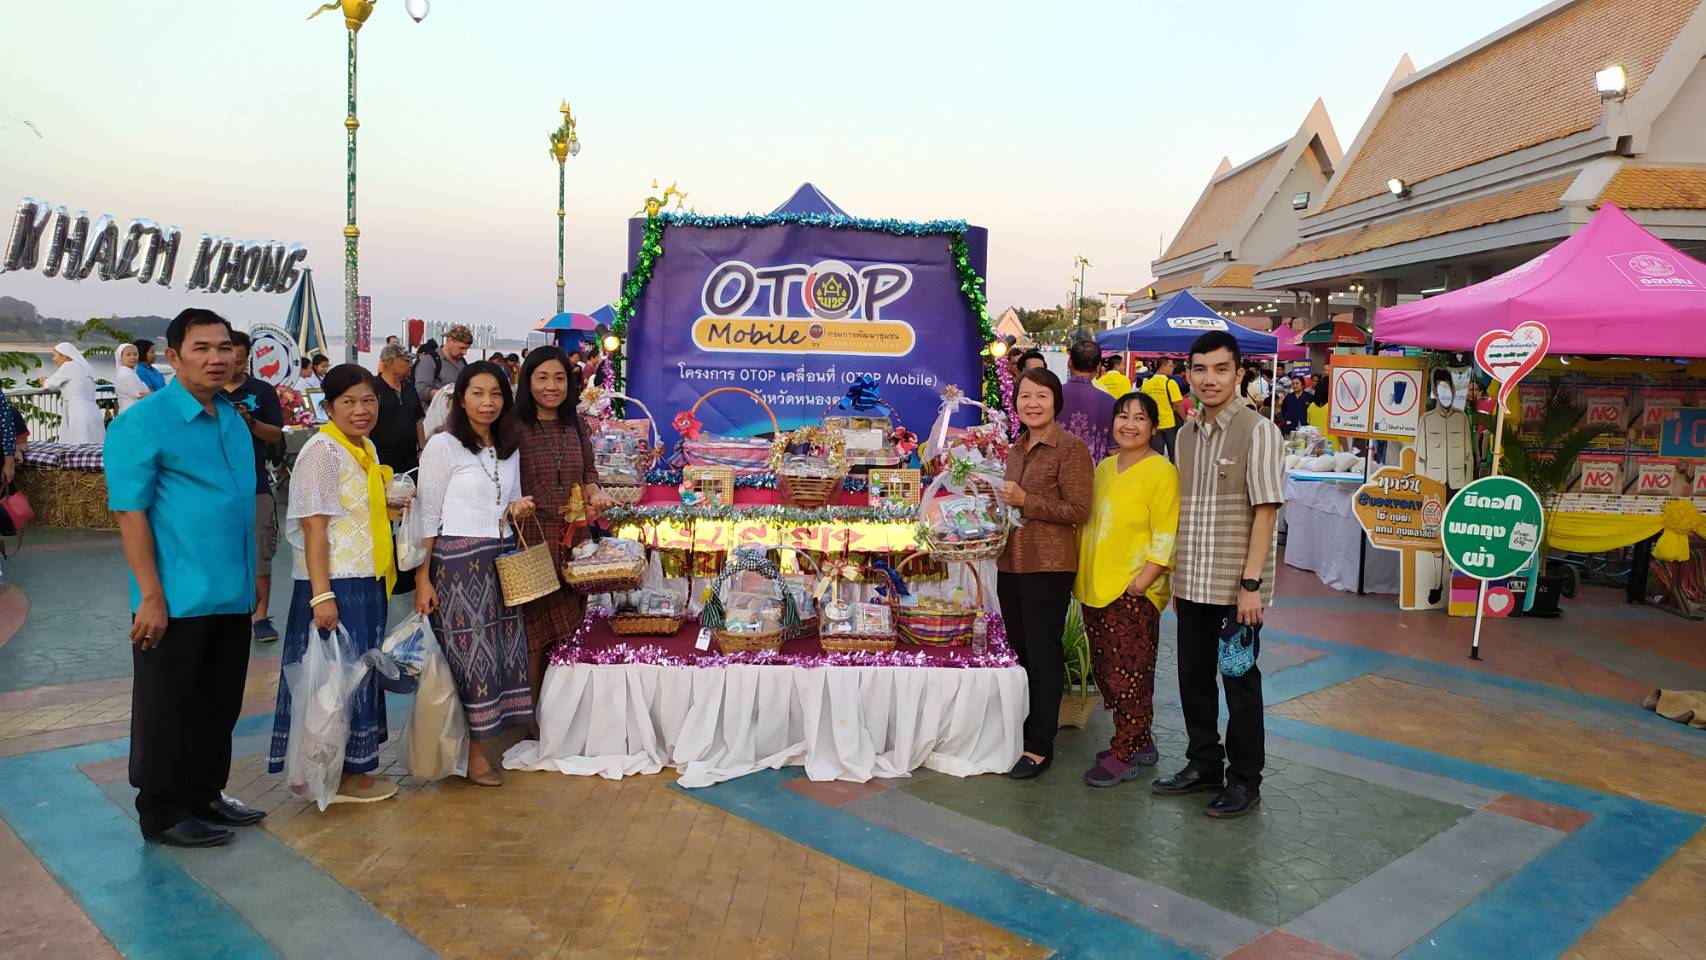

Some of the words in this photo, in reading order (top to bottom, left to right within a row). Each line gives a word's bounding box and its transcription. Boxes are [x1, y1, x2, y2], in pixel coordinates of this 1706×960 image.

[186, 232, 308, 294] KHONG
[705, 261, 908, 321] OTOP
[707, 322, 807, 345] Mobile
[677, 362, 735, 381] โครงการ
[740, 368, 776, 381] OTOP
[781, 363, 836, 382] เคลื่อนที่
[841, 371, 881, 384] (OP
[886, 372, 938, 387] Mobile)
[1378, 473, 1421, 496] ทุกวัน
[1464, 490, 1522, 511] ยืดอก
[1375, 525, 1394, 535] แทน
[1448, 521, 1507, 541] พกถุง
[1462, 546, 1495, 568] ผ้า
